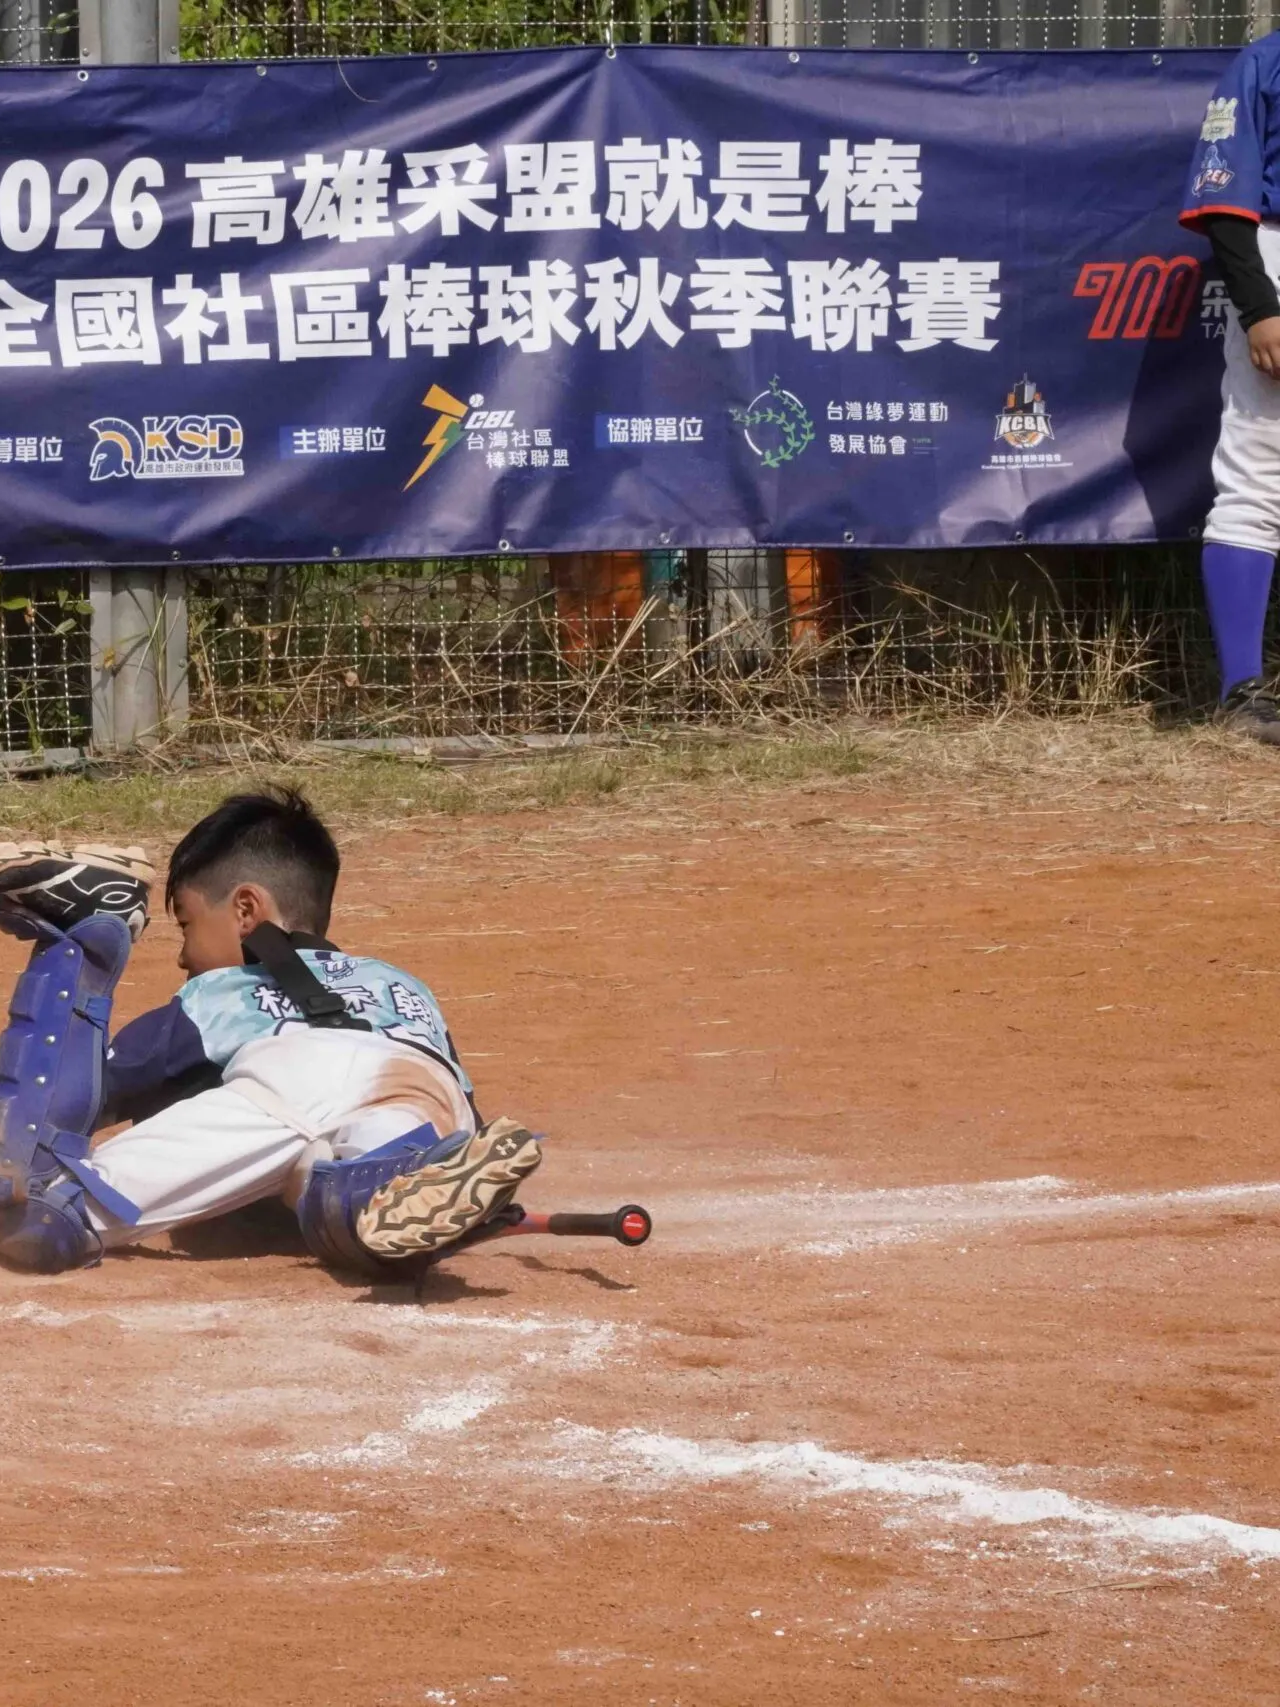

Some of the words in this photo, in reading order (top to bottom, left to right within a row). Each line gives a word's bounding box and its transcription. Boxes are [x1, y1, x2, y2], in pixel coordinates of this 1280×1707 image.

[184, 137, 922, 248] 高雄采盟就是棒
[464, 410, 516, 430] CBL
[826, 400, 949, 422] 台灣緣夢運動
[607, 417, 705, 444] 協辦單位
[998, 415, 1051, 437] KCBA
[142, 414, 244, 463] KSD
[292, 427, 386, 454] 主辦單位
[466, 428, 553, 450] 台灣社區
[828, 433, 908, 456] 發展協會
[485, 448, 570, 469] 棒球聯盟
